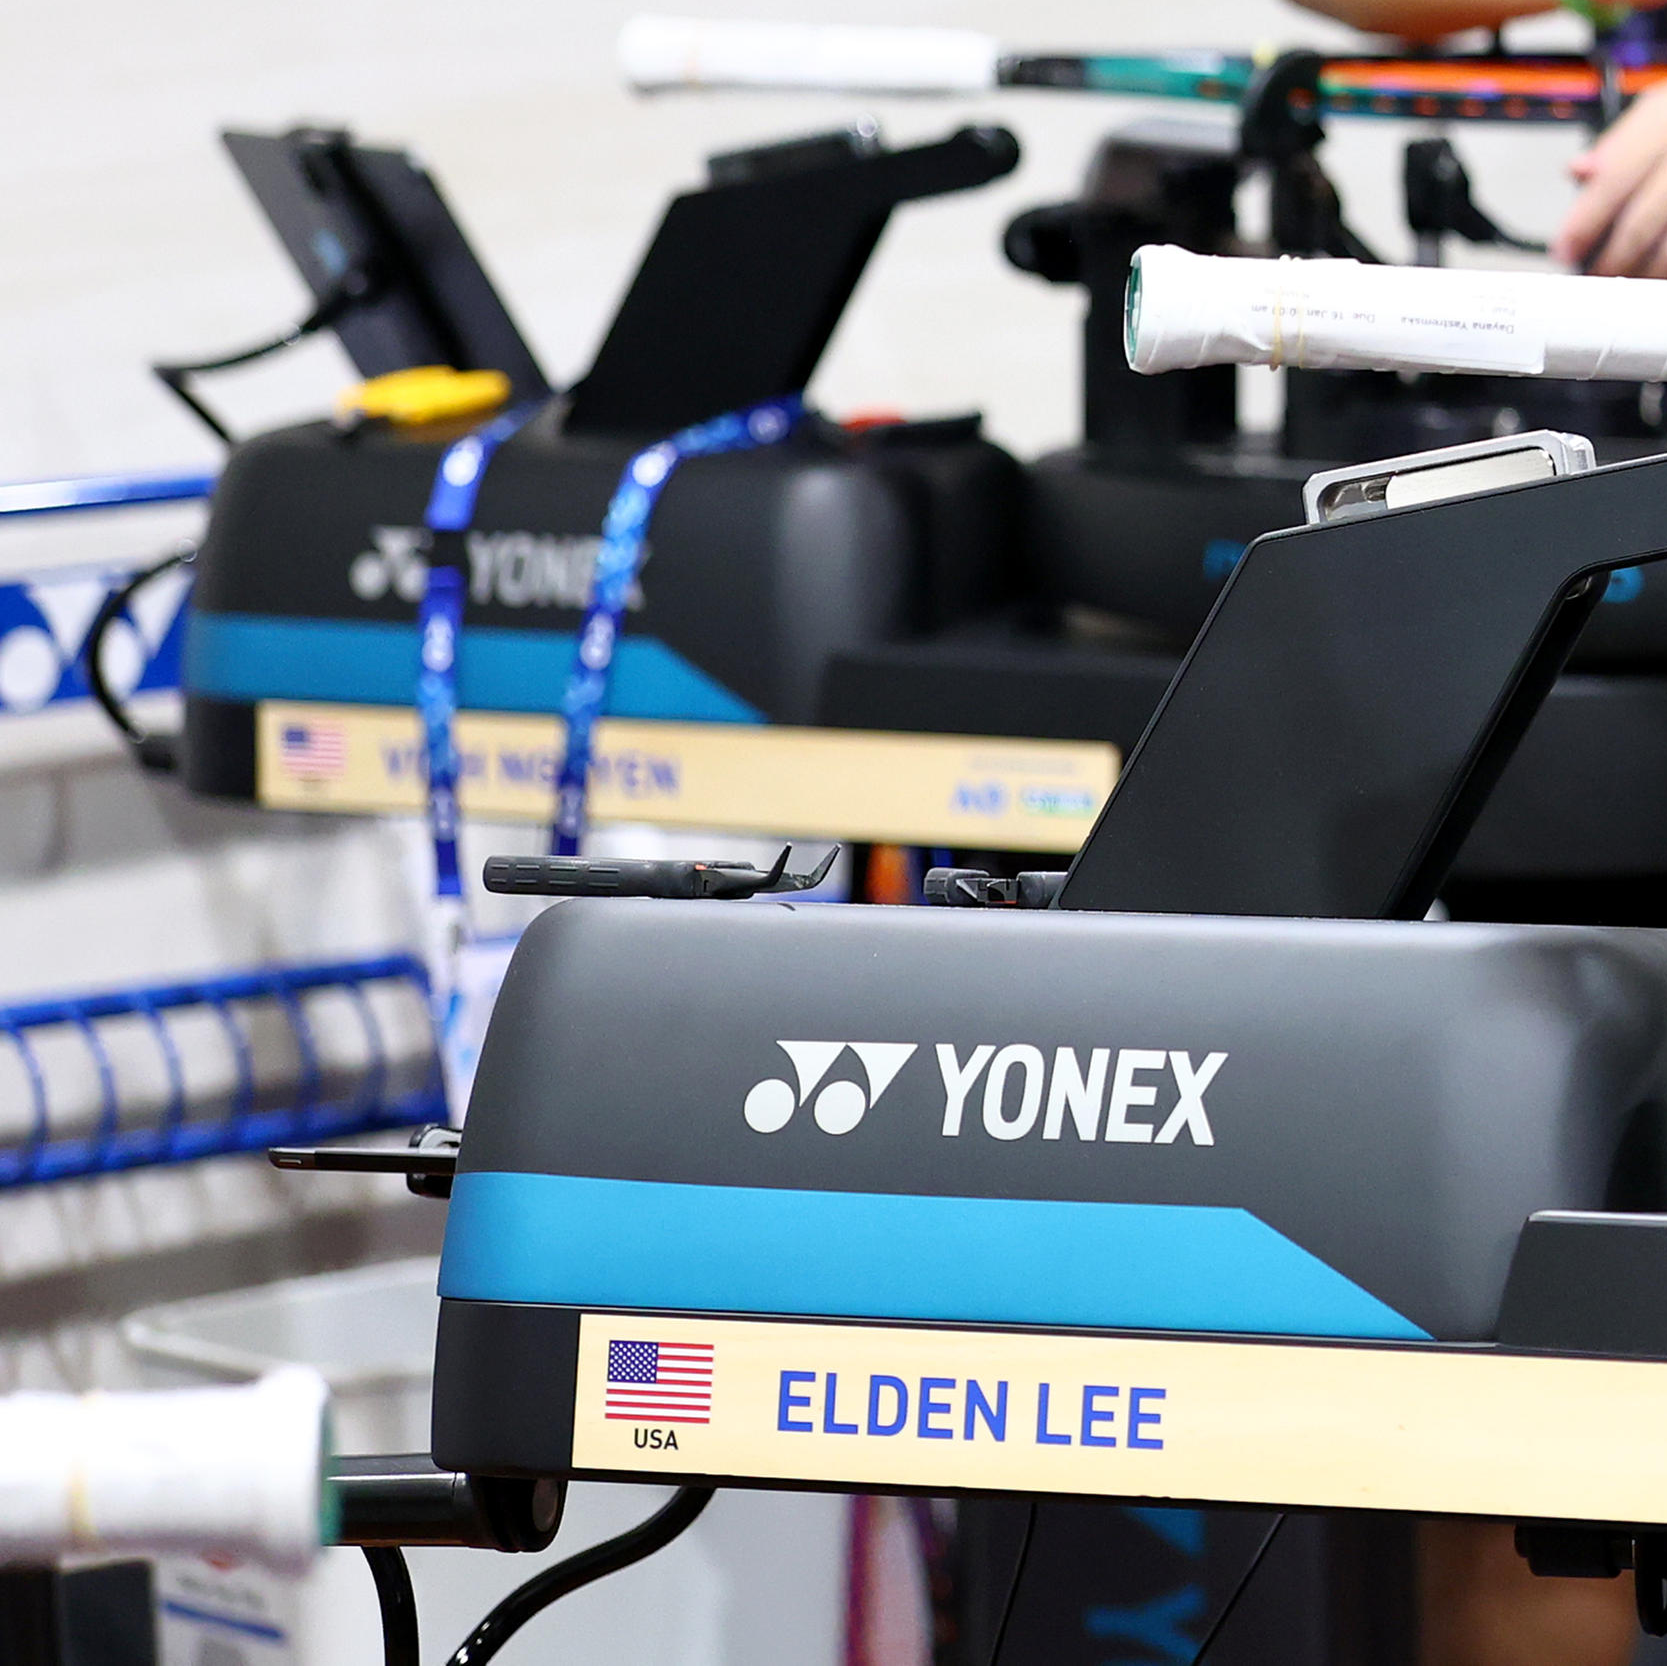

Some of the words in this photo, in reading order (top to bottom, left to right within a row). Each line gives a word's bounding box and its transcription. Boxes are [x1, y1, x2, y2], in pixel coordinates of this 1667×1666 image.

[1473, 321, 1515, 335] Dayana
[935, 1043, 1229, 1146] YONEX
[777, 1370, 1008, 1442] ELDEN
[1036, 1382, 1166, 1450] LEE
[633, 1428, 678, 1451] USA
